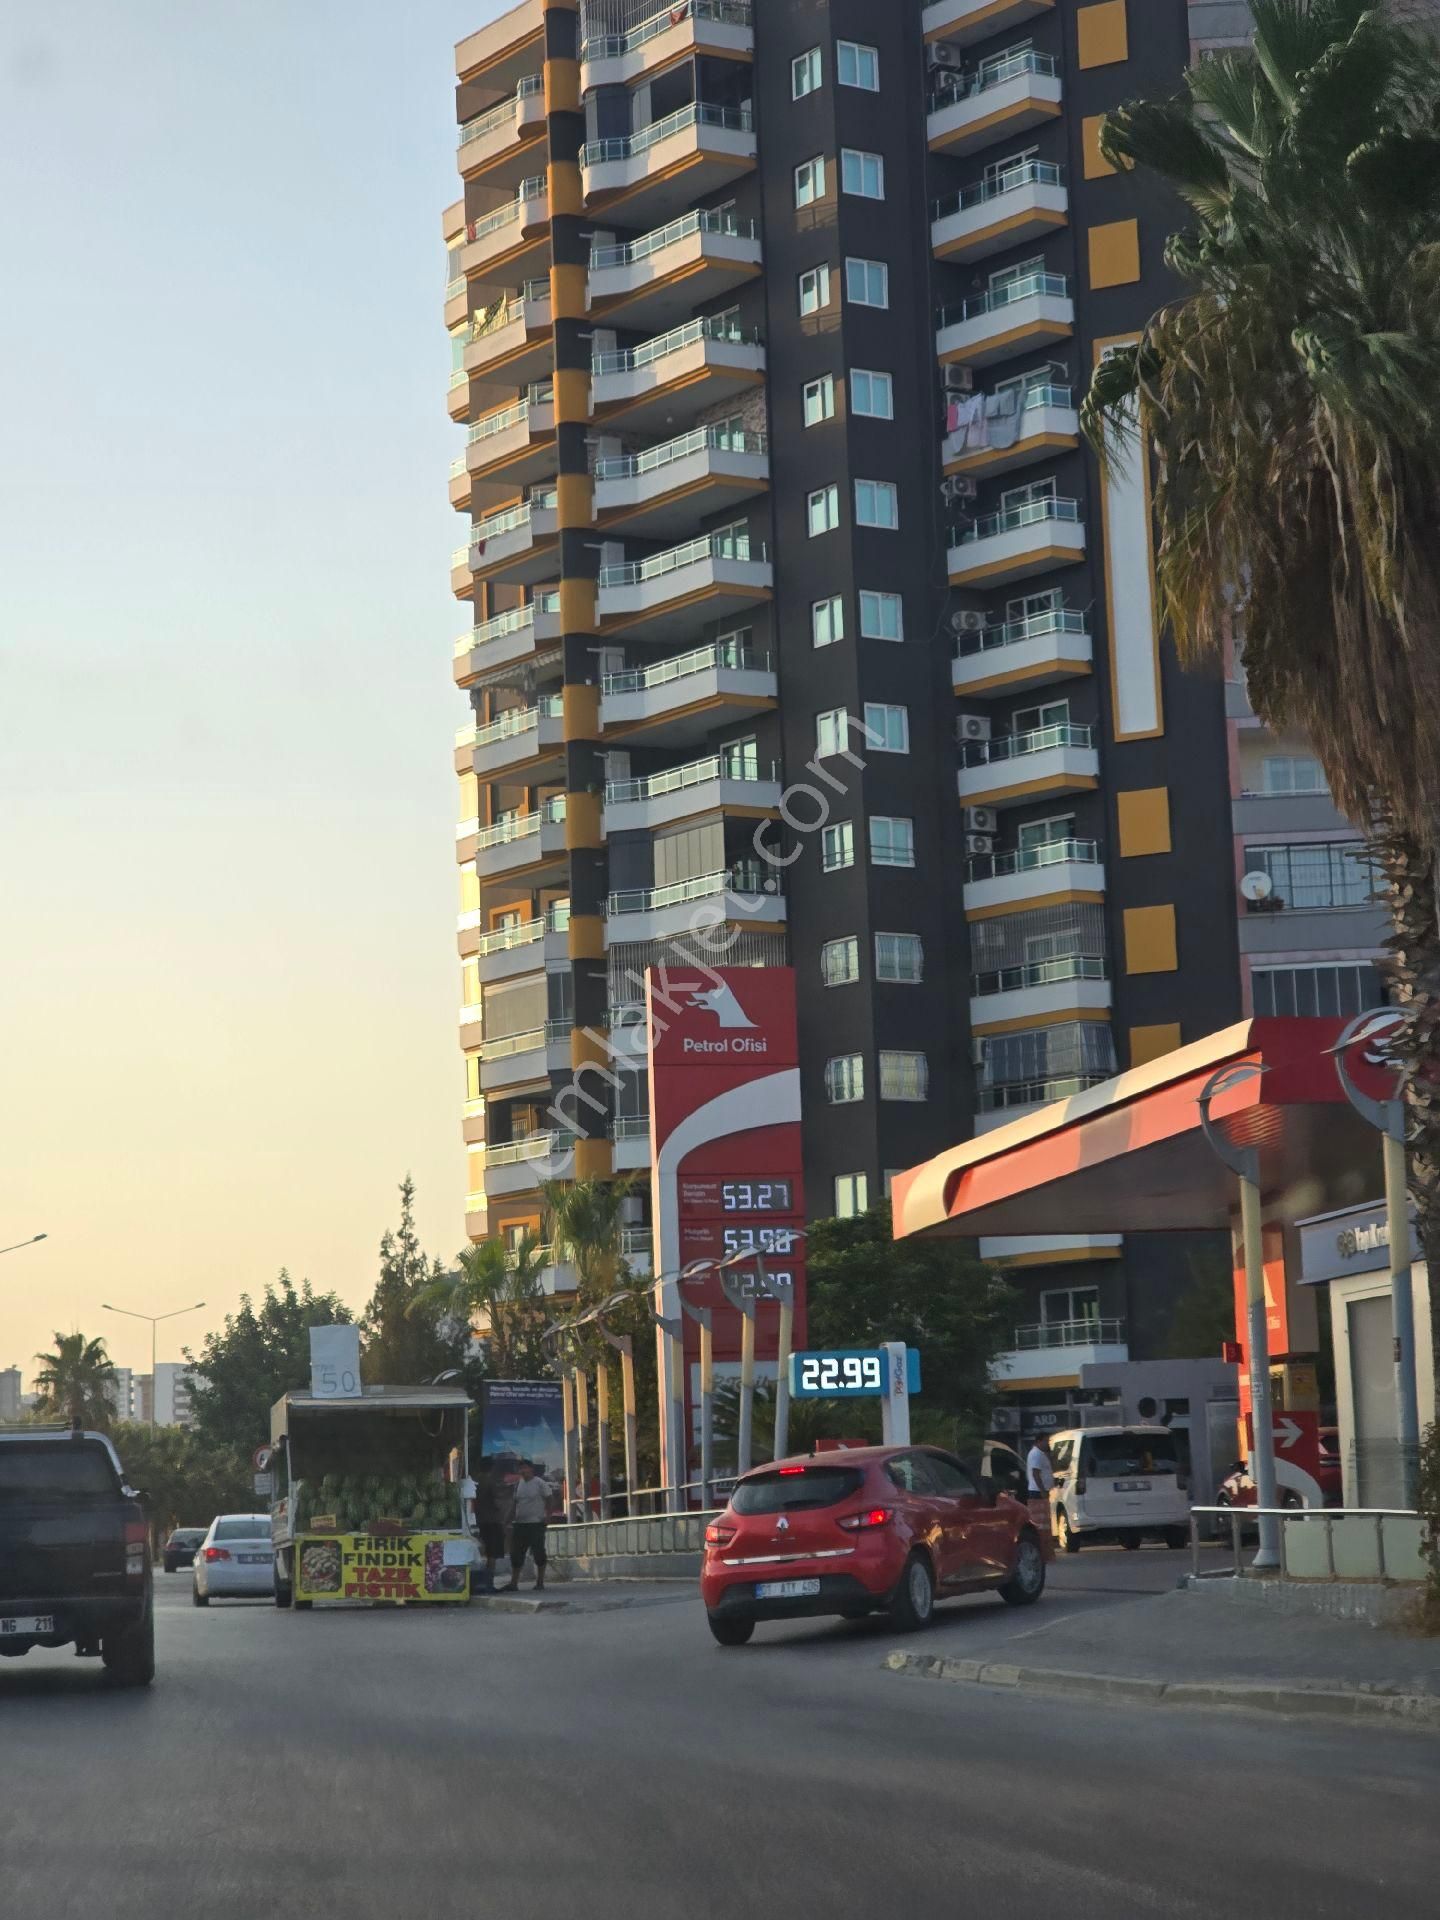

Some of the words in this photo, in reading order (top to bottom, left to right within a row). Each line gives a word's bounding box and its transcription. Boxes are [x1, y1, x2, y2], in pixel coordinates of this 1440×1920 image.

[683, 1037, 728, 1053] Petrol
[731, 1037, 768, 1053] Ofisi
[723, 1185, 789, 1209] 53.27
[724, 1229, 791, 1254] 5398
[321, 1370, 356, 1393] 50
[802, 1357, 880, 1390] 22.99
[344, 1553, 422, 1567] FINDIK
[353, 1567, 412, 1582] TAZE
[345, 1582, 421, 1598] FISTIK
